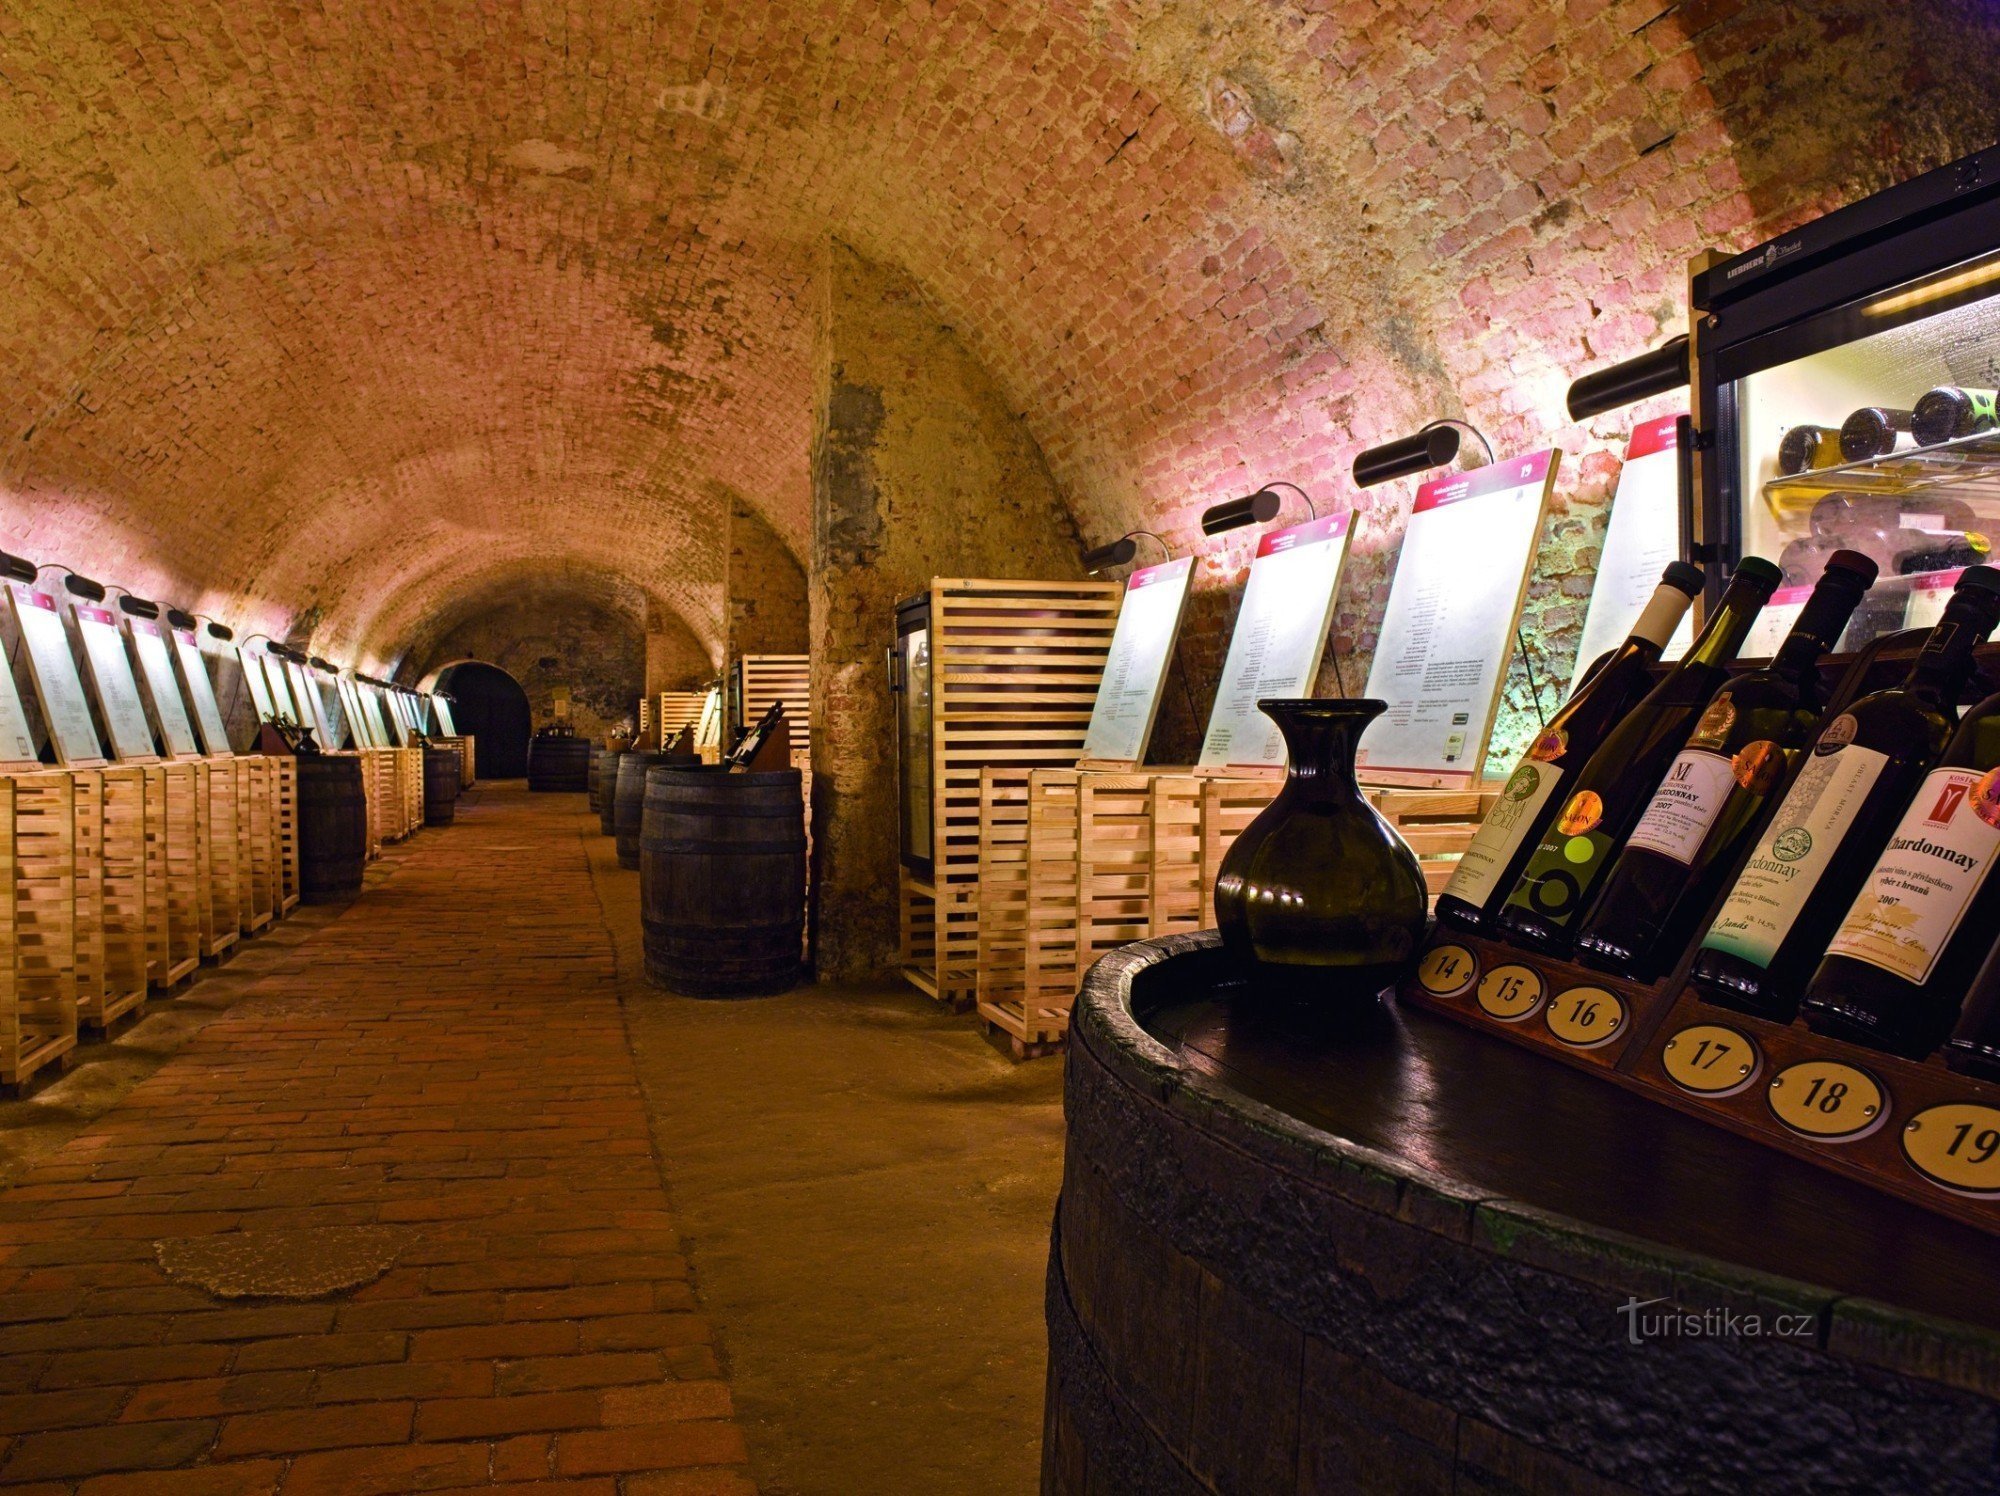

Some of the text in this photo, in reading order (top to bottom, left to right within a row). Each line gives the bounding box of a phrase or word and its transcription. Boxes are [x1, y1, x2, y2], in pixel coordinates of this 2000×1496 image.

[1727, 256, 1765, 279] LIEBHERR
[1520, 463, 1533, 479] 19
[1671, 762, 1694, 781] M
[1655, 802, 1673, 810] 2007
[1656, 789, 1699, 802] ARDONNAY
[1825, 799, 1848, 832] MORAVA
[1543, 843, 1558, 852] 2007
[1886, 838, 1978, 873] Chardonnay
[1745, 856, 1800, 882] ardonnay
[1877, 895, 1900, 907] 2007
[1902, 882, 1929, 897] hroznů
[1434, 955, 1460, 979] 14
[1496, 976, 1525, 1002] 15
[1569, 999, 1601, 1027] 16
[1690, 1040, 1732, 1070] 17
[1803, 1078, 1848, 1114] 18
[1946, 1123, 2000, 1164] 19
